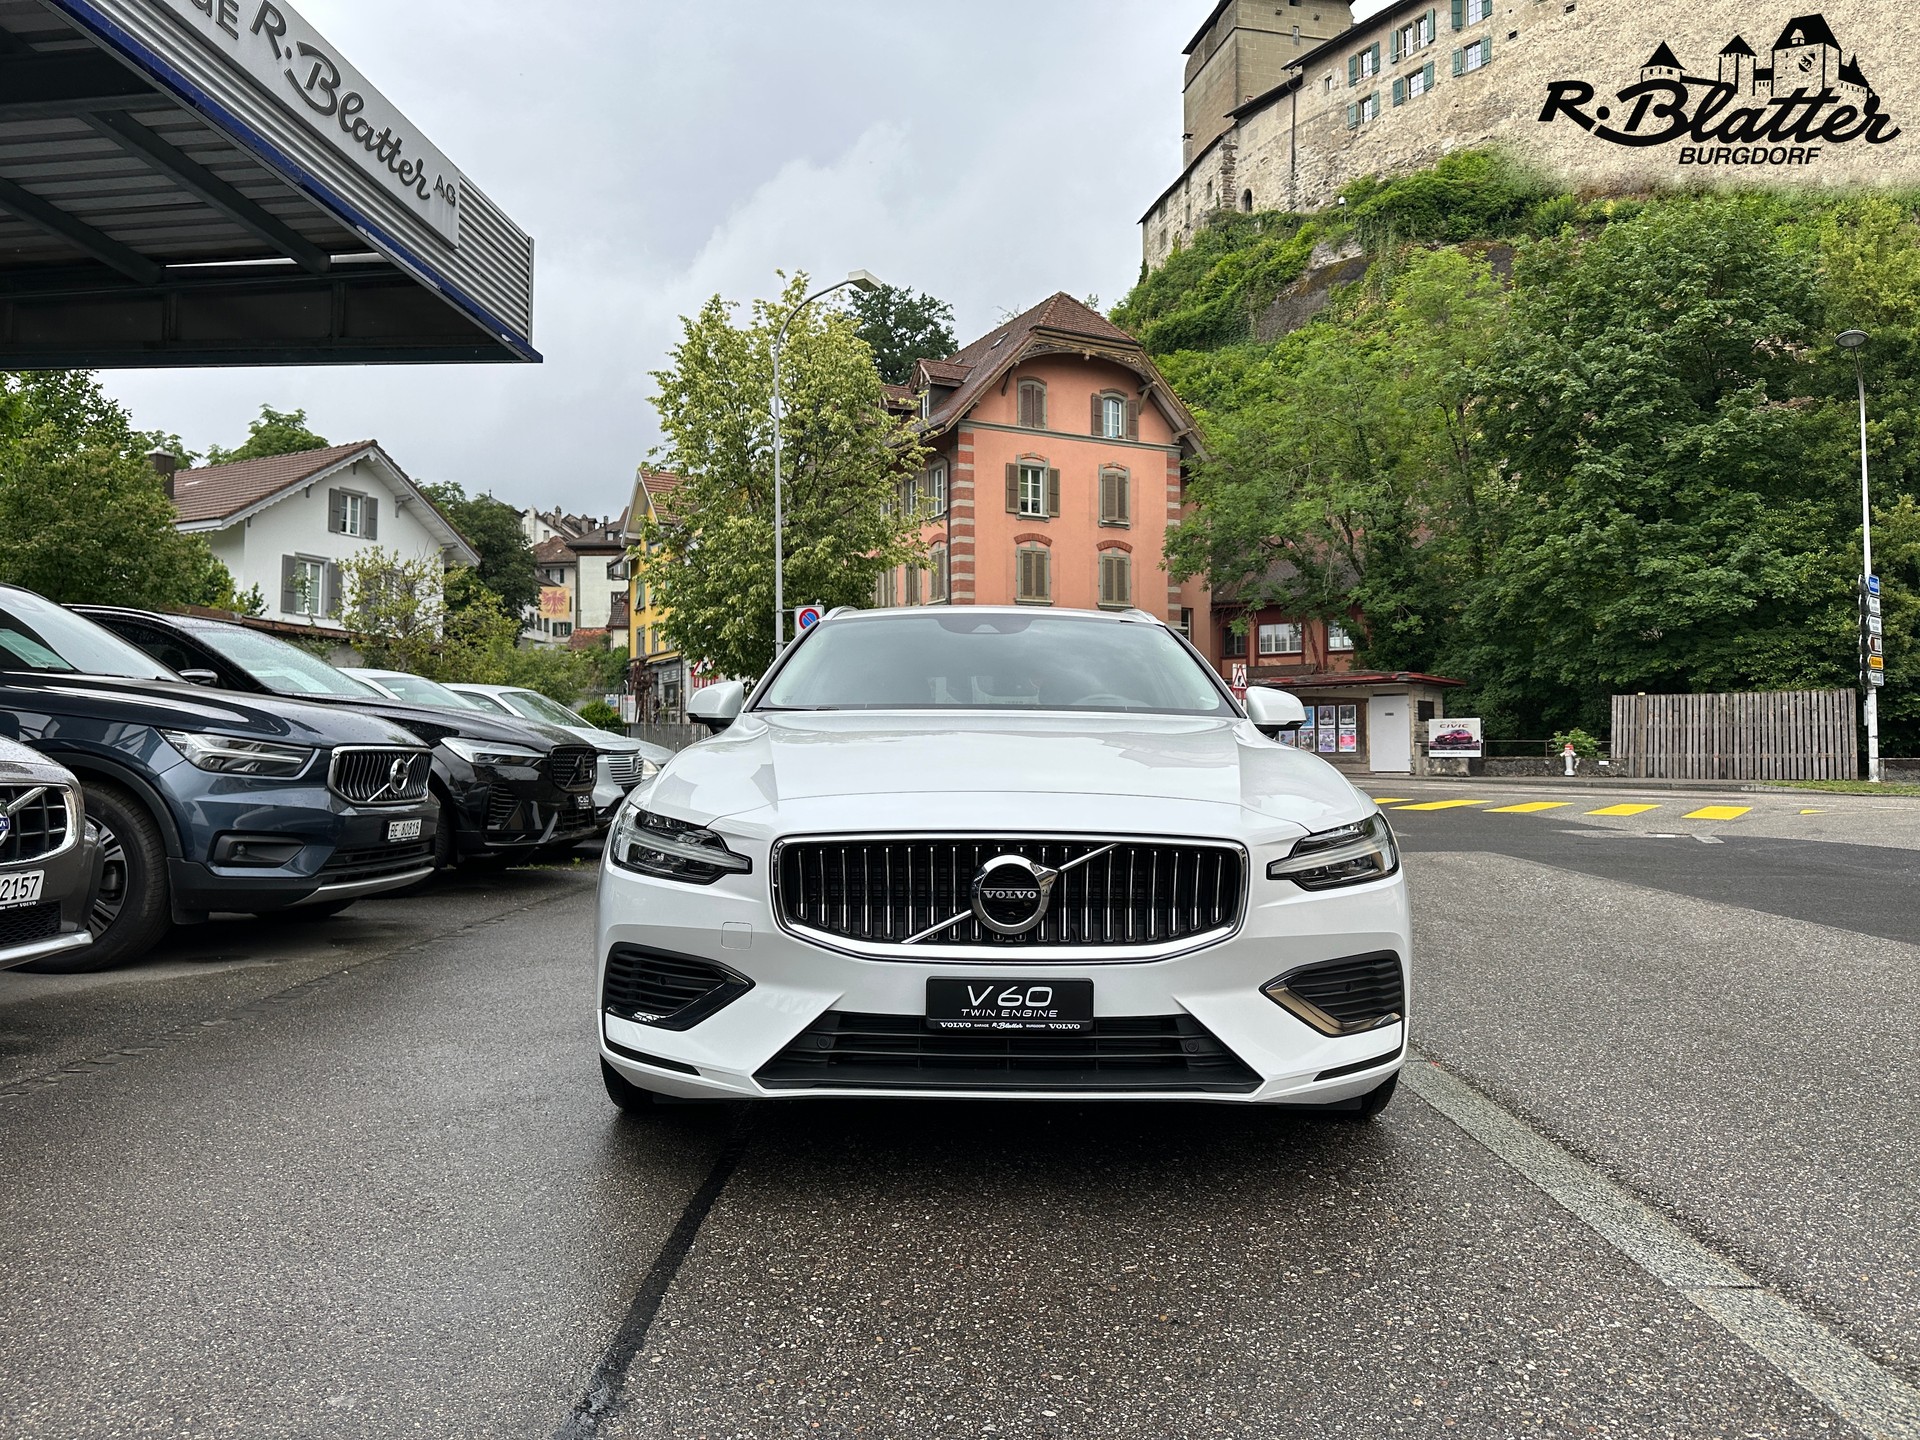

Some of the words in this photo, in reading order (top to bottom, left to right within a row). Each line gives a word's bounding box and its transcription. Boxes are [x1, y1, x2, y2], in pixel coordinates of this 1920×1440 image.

[433, 174, 457, 208] AG
[390, 823, 399, 838] BE
[983, 890, 1037, 899] VOLVO
[961, 1008, 997, 1017] TWIN
[1001, 1009, 1059, 1018] ENGINE
